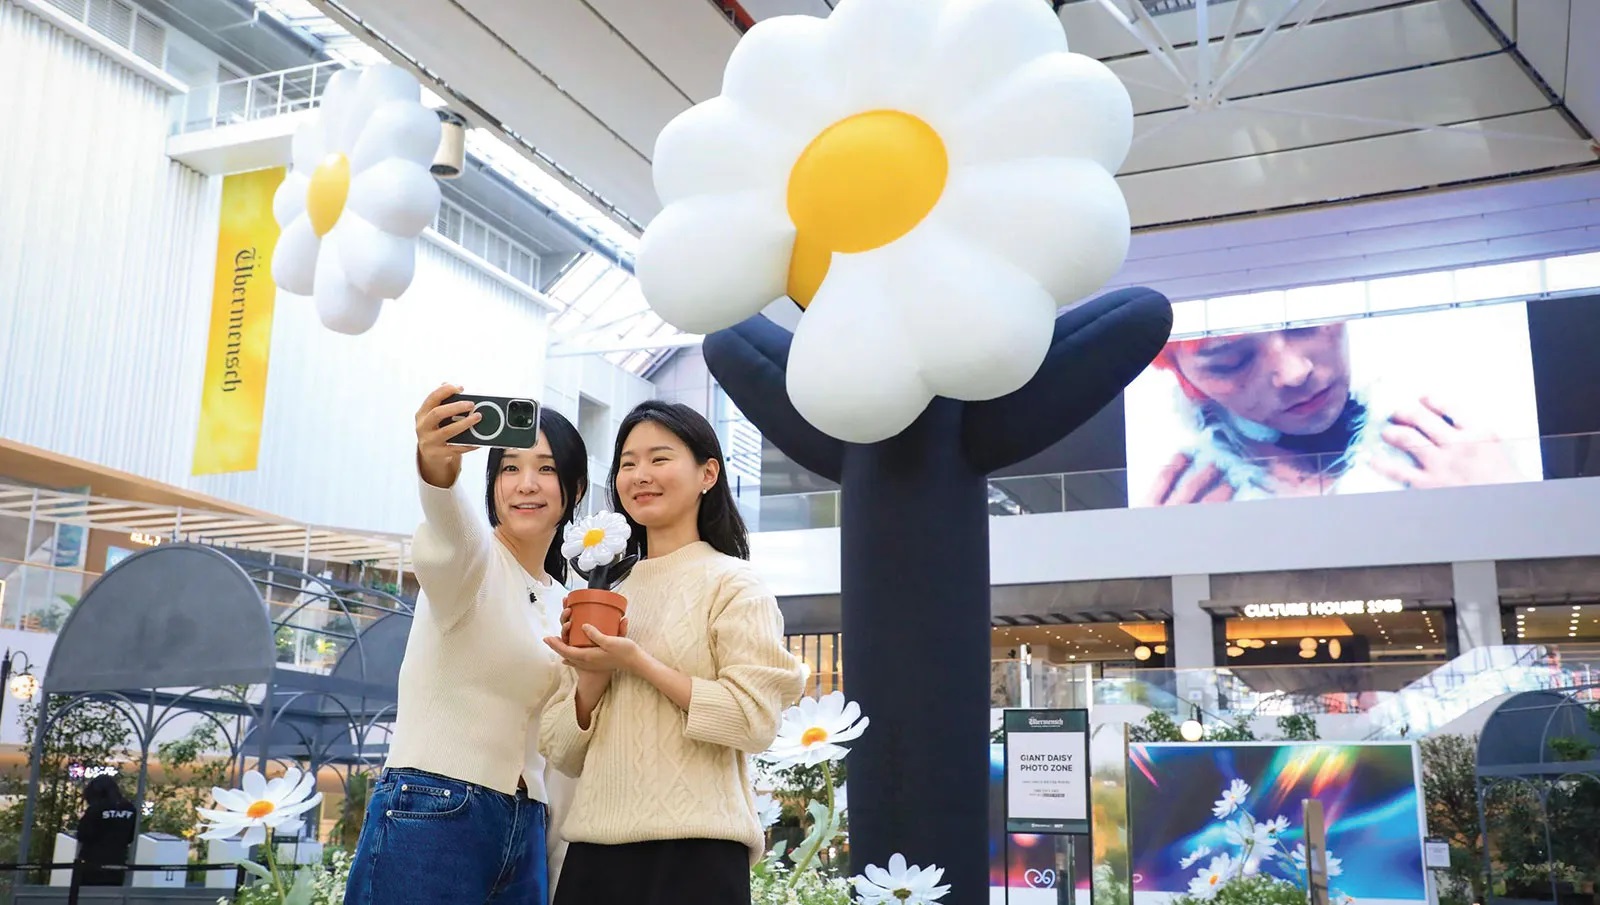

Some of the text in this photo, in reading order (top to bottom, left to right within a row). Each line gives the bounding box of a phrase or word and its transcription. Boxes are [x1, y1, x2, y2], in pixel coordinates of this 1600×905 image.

[222, 247, 262, 392] Übermensch
[1244, 602, 1309, 618] CULTURE
[1311, 601, 1365, 616] HOUSE
[1020, 754, 1073, 762] GIANT DAISY
[1020, 764, 1073, 772] PHOTO ZONE
[102, 810, 134, 819] STAFF
